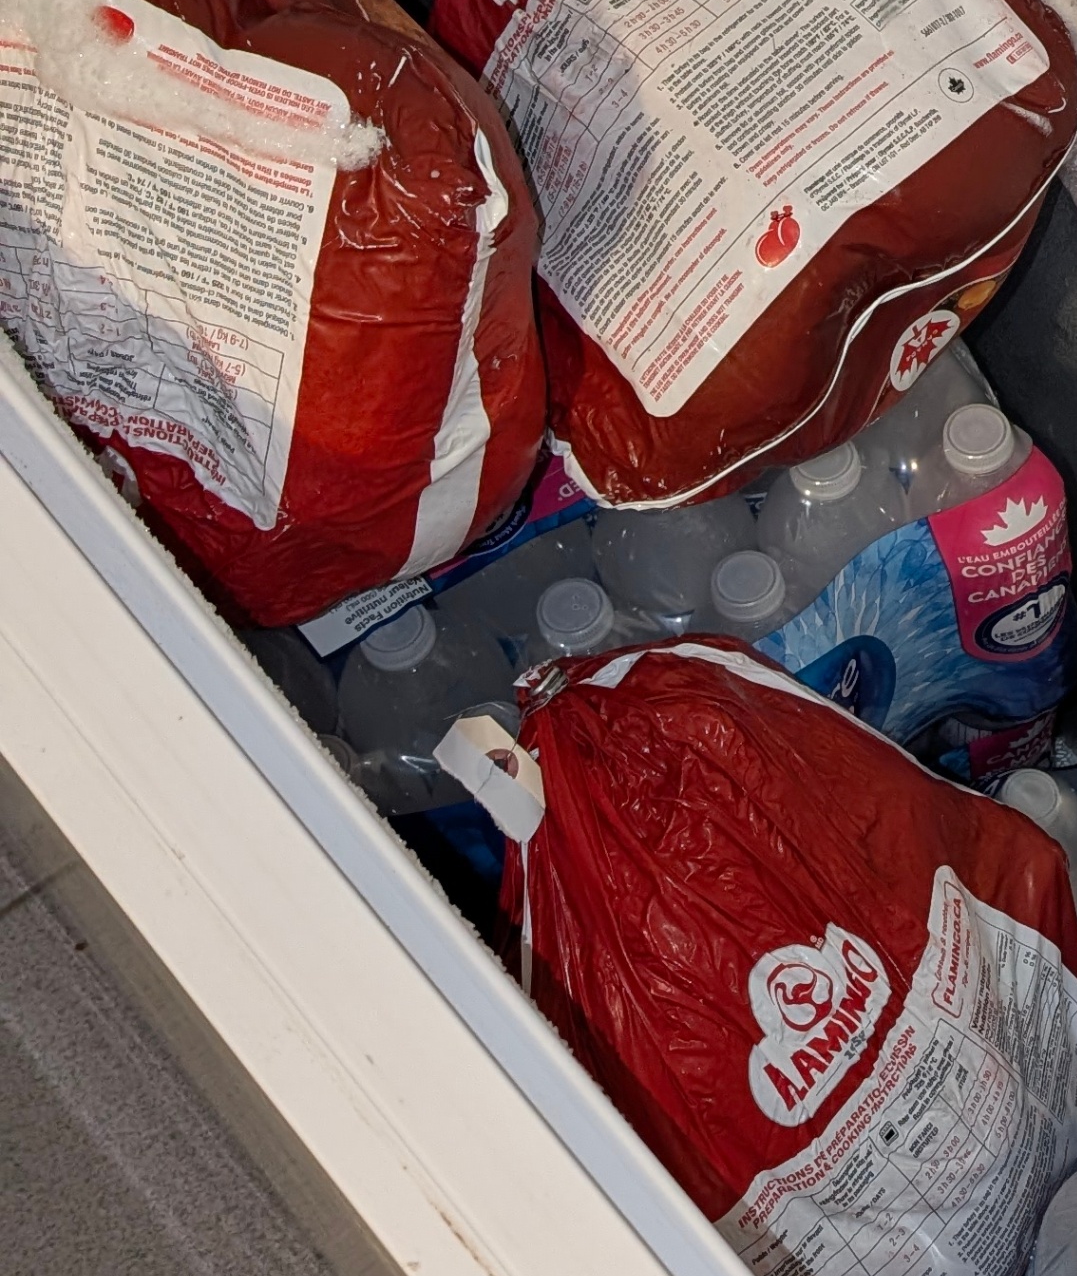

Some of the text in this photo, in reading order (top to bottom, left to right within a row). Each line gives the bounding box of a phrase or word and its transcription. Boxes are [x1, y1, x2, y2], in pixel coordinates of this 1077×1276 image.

[343, 575, 422, 625] Valeur nutritive
[353, 583, 429, 633] Nutrition Facts
[942, 898, 961, 1005] FLAMINGO.CA
